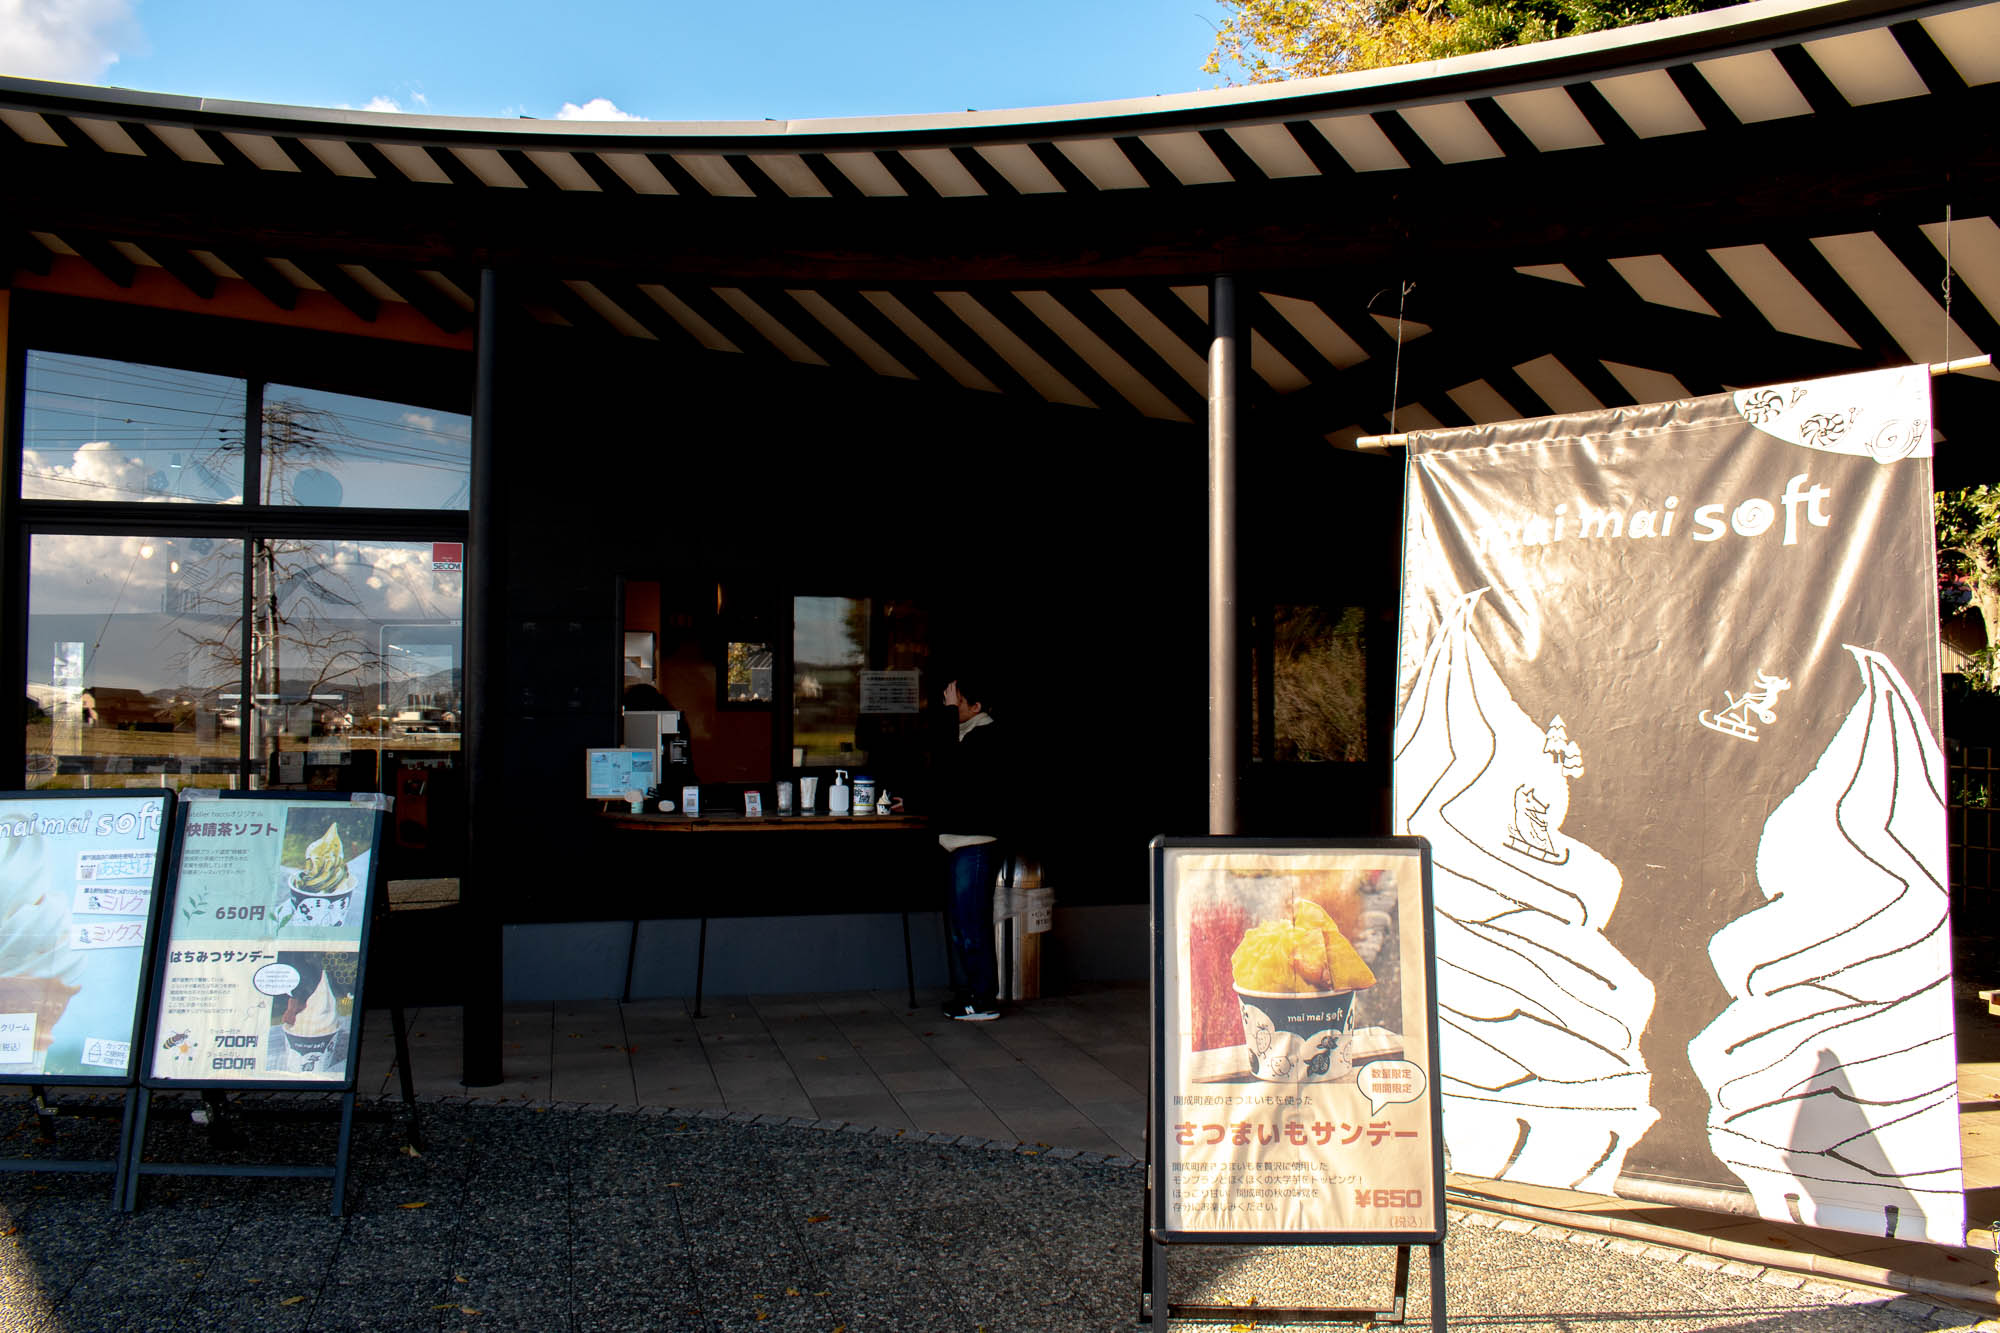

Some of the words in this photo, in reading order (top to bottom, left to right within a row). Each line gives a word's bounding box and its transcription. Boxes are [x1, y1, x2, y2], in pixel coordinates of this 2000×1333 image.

[1579, 495, 1680, 538] mai
[1693, 473, 1831, 546] soft
[41, 810, 92, 834] mai
[96, 801, 162, 840] soft
[185, 822, 279, 837] 快晴茶ソフト
[101, 895, 144, 911] ミルク
[215, 905, 266, 921] 650円
[92, 923, 144, 941] ミックス
[169, 950, 275, 964] はちみつサンデー
[1287, 1014, 1305, 1023] mai
[1306, 1012, 1324, 1022] mai
[1325, 1008, 1344, 1022] soft
[0, 1023, 31, 1033] クリーム
[215, 1035, 259, 1048] 700円
[212, 1058, 257, 1070] 600円
[1371, 1068, 1413, 1080] 数量限定
[1371, 1083, 1413, 1095] 期間限定
[1174, 1120, 1418, 1147] さつまいもサンデー
[1355, 1189, 1423, 1209] ¥650
[1390, 1215, 1424, 1229] (税込)
